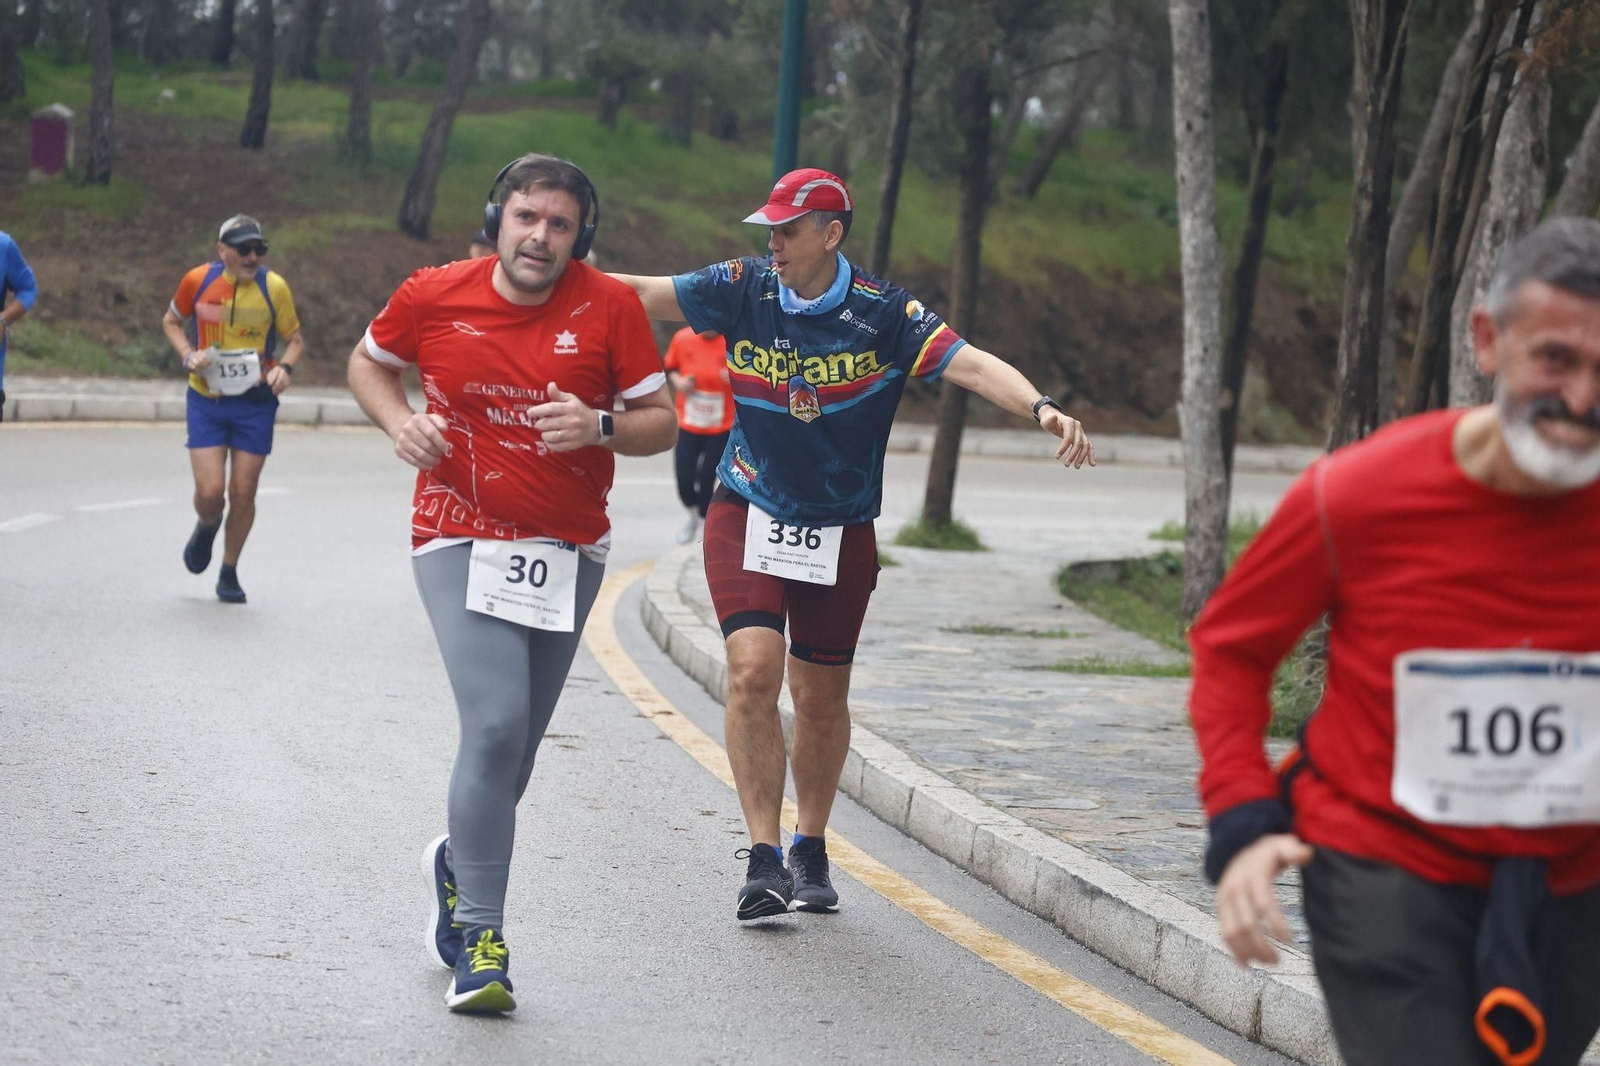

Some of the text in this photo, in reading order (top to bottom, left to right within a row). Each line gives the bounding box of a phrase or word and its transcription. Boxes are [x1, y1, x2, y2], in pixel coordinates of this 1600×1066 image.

[850, 317, 879, 335] Deportes
[774, 336, 791, 349] tra
[218, 362, 249, 378] 153
[481, 384, 545, 401] GENERALI
[768, 519, 822, 550] 336
[505, 554, 548, 588] 30
[1448, 704, 1565, 757] 106
